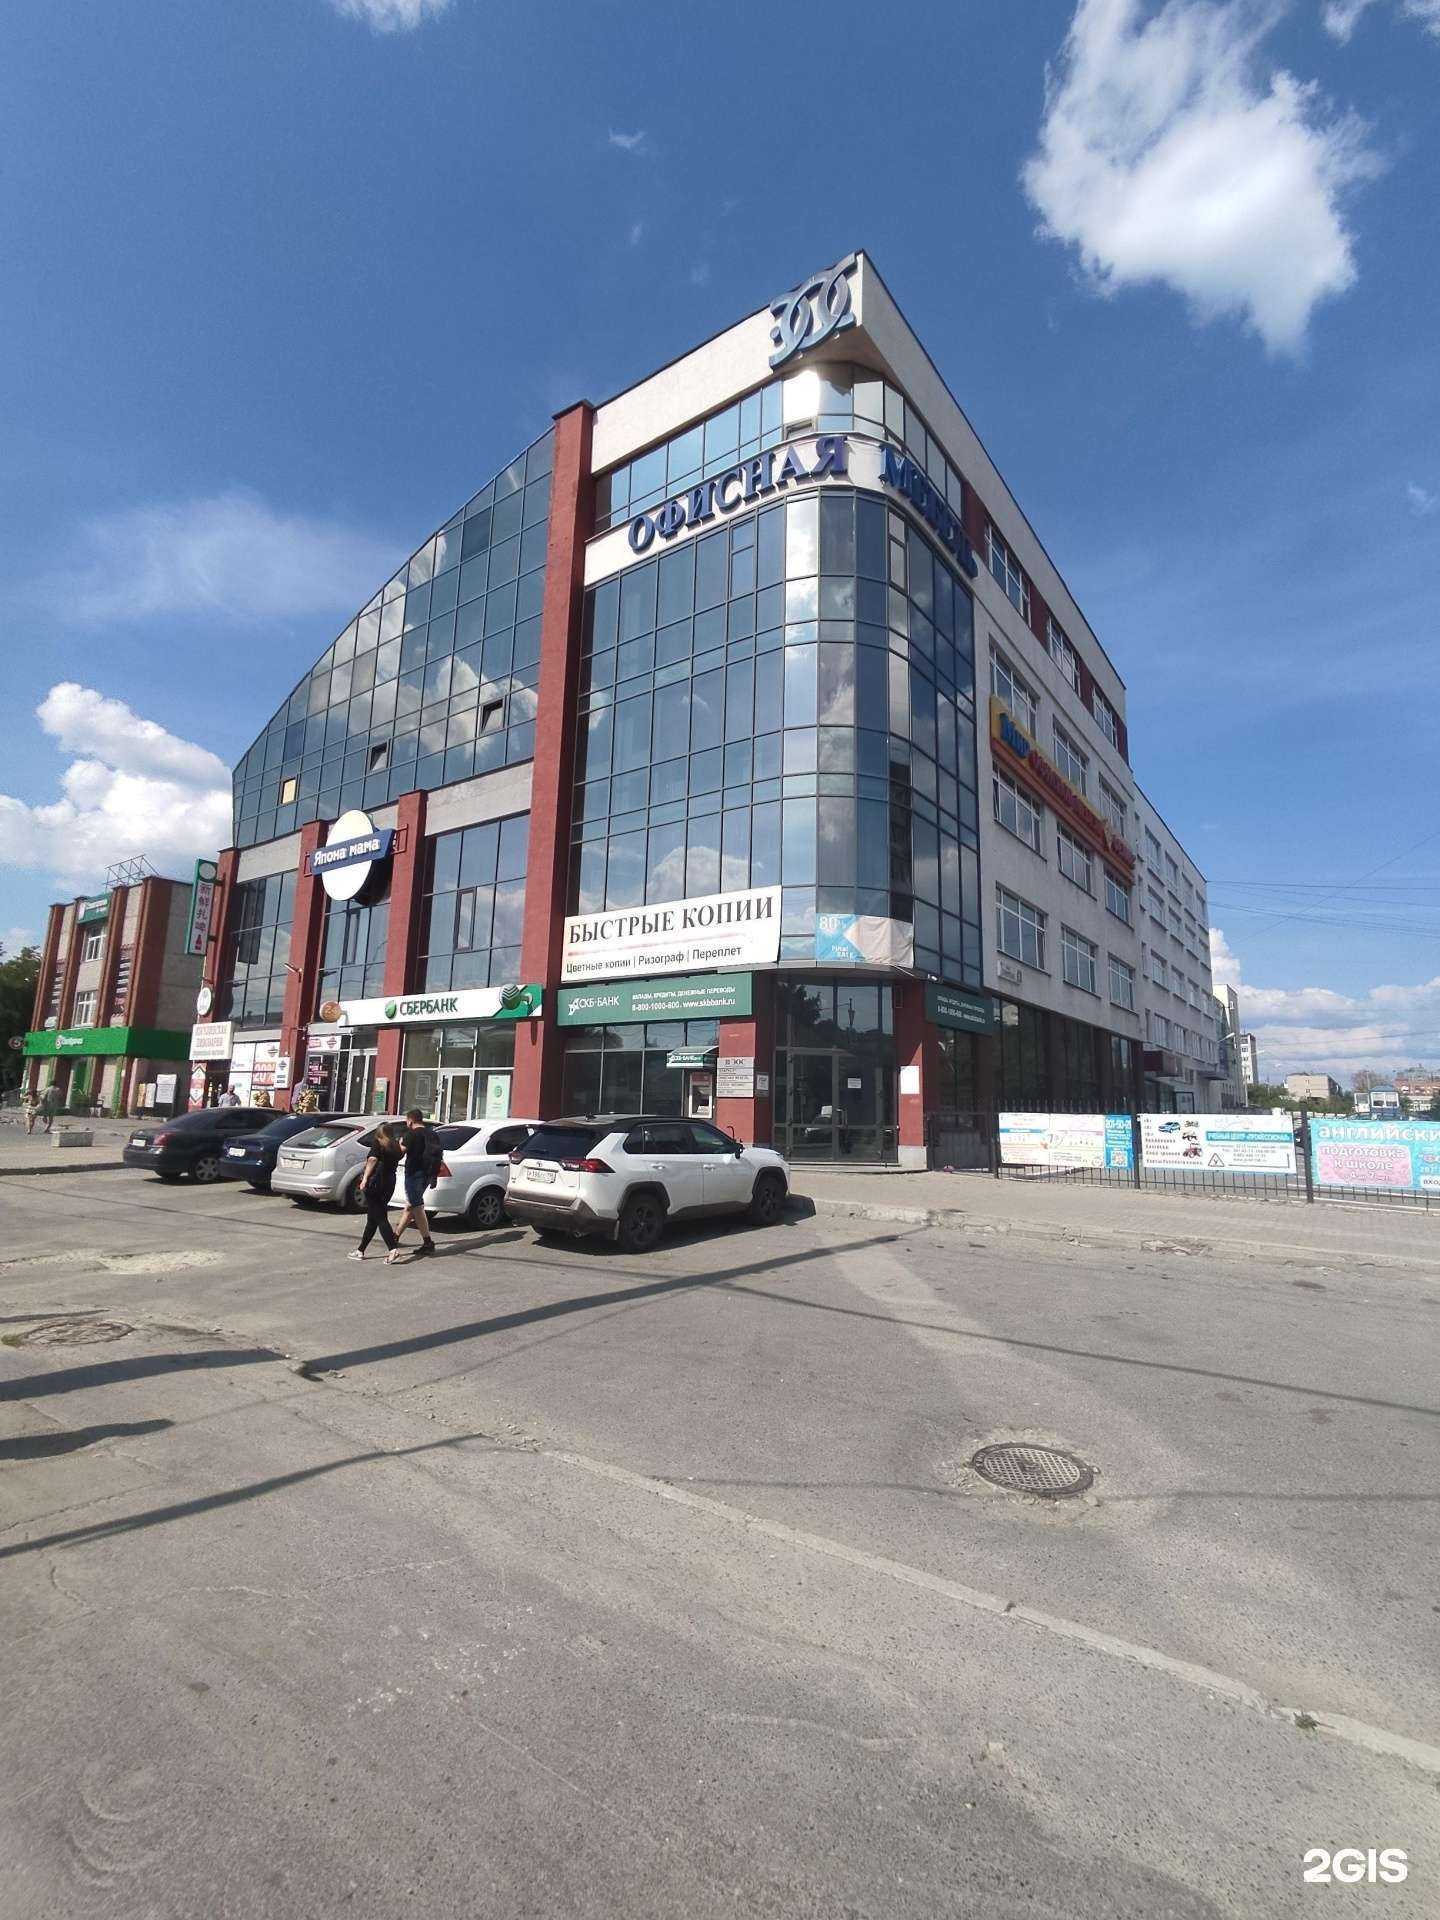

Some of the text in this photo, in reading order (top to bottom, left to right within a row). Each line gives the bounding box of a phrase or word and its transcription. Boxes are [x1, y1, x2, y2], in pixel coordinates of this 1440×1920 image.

[628, 435, 849, 554] ОФИСНАЯ
[314, 839, 380, 867] Япона мама
[569, 896, 774, 944] БЫСТРЫЕ КОПИИ
[566, 947, 741, 974] Цветные копии Ризограф Переплет
[400, 997, 458, 1016] СБЕРБАНК
[579, 995, 620, 1009] СКБ-БАНК
[1323, 1147, 1406, 1159] подготовка
[1334, 1160, 1393, 1170] к школе
